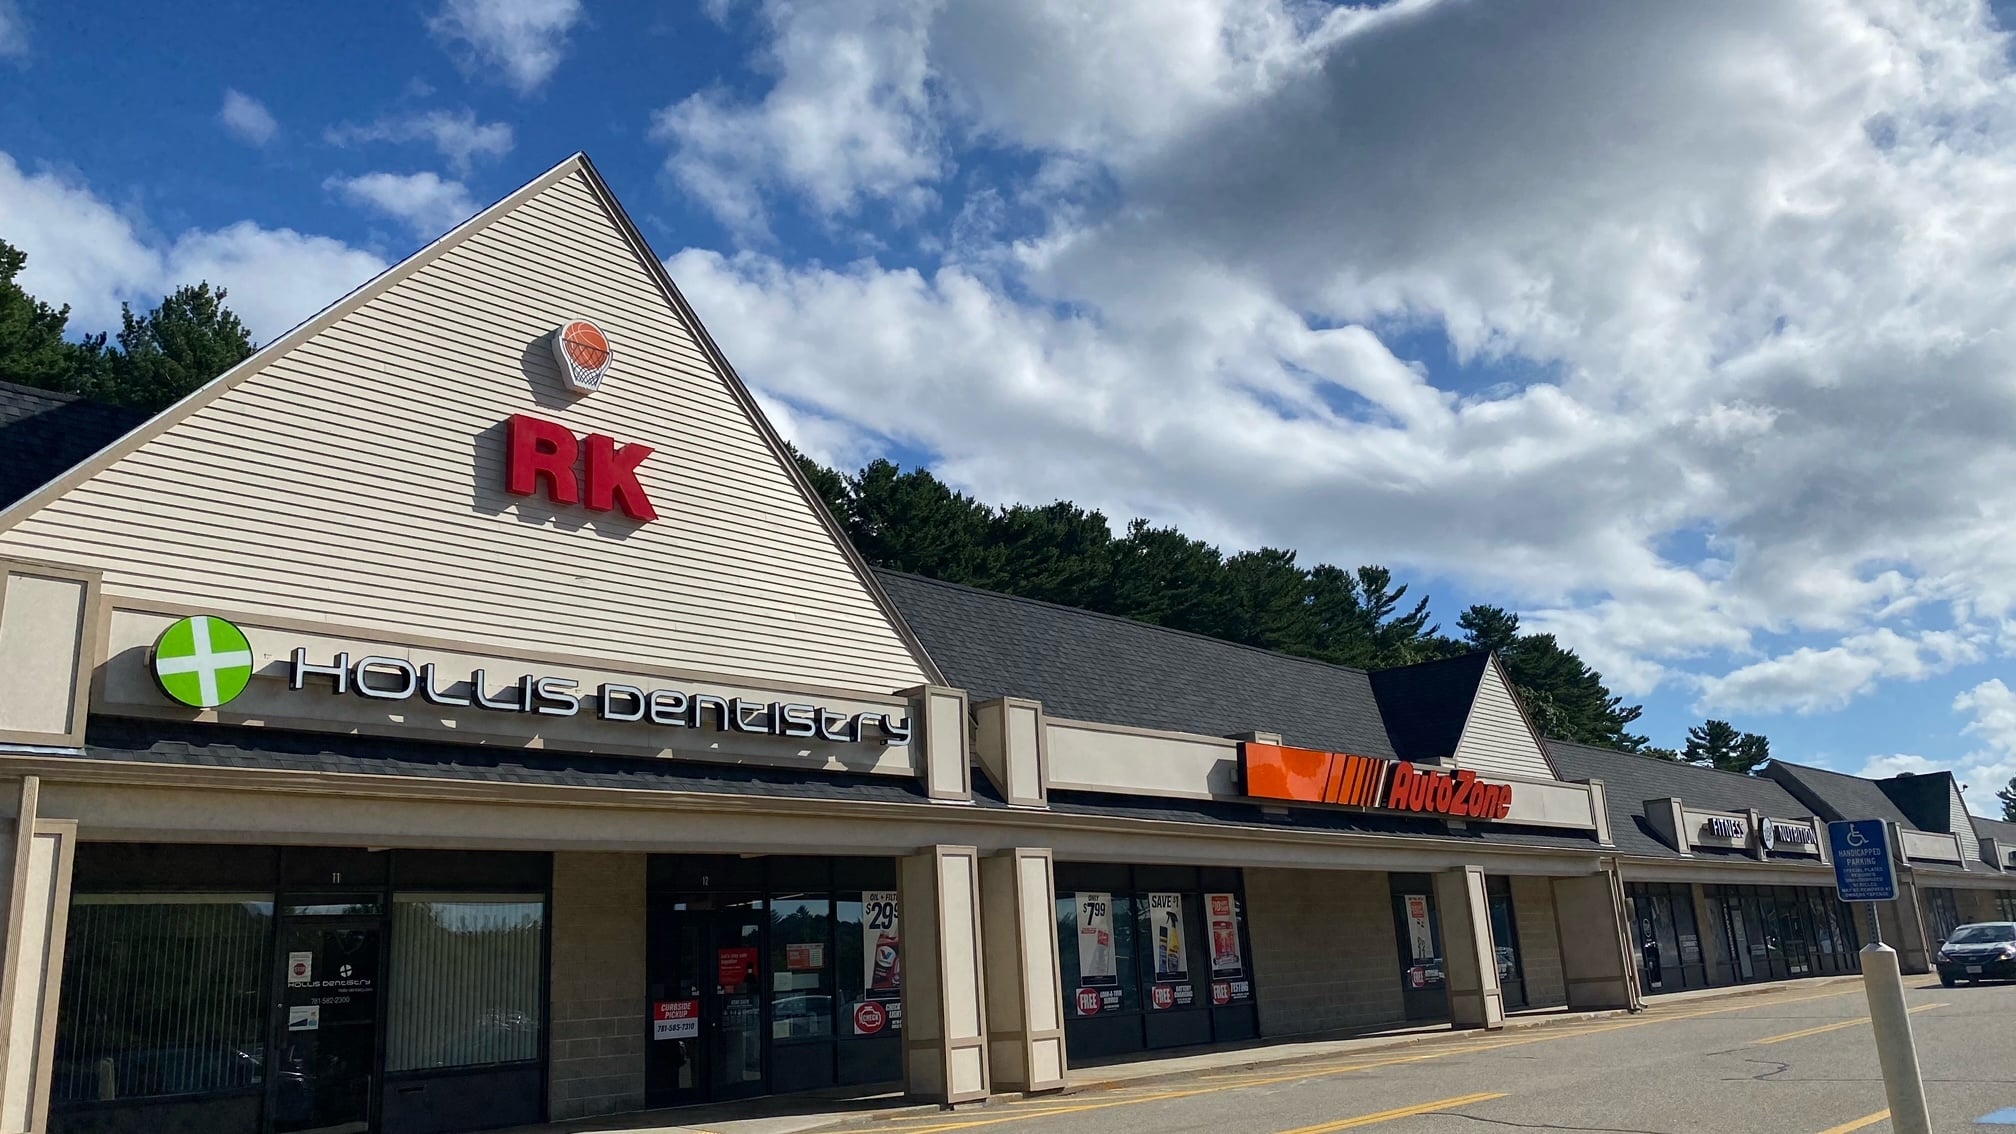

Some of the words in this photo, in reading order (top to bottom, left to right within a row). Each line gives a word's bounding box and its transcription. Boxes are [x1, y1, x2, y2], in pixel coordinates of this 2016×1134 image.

[506, 413, 659, 521] RK
[289, 647, 580, 716] HOLLIS
[1387, 761, 1512, 819] AutoZone
[1711, 818, 1744, 838] FITNESS
[1778, 825, 1817, 844] NUTRITION
[1838, 847, 1881, 857] HANDICAPPED
[1846, 858, 1876, 866] PARKING
[885, 893, 898, 901] FILT
[1151, 895, 1172, 908] SAVE
[1155, 988, 1171, 1003] FREE
[1213, 984, 1228, 999] FREE
[661, 1002, 692, 1011] CURBSIDE
[1080, 994, 1097, 1009] FREE
[665, 1010, 688, 1019] PICKUP
[657, 1023, 694, 1032] 781-585-7310
